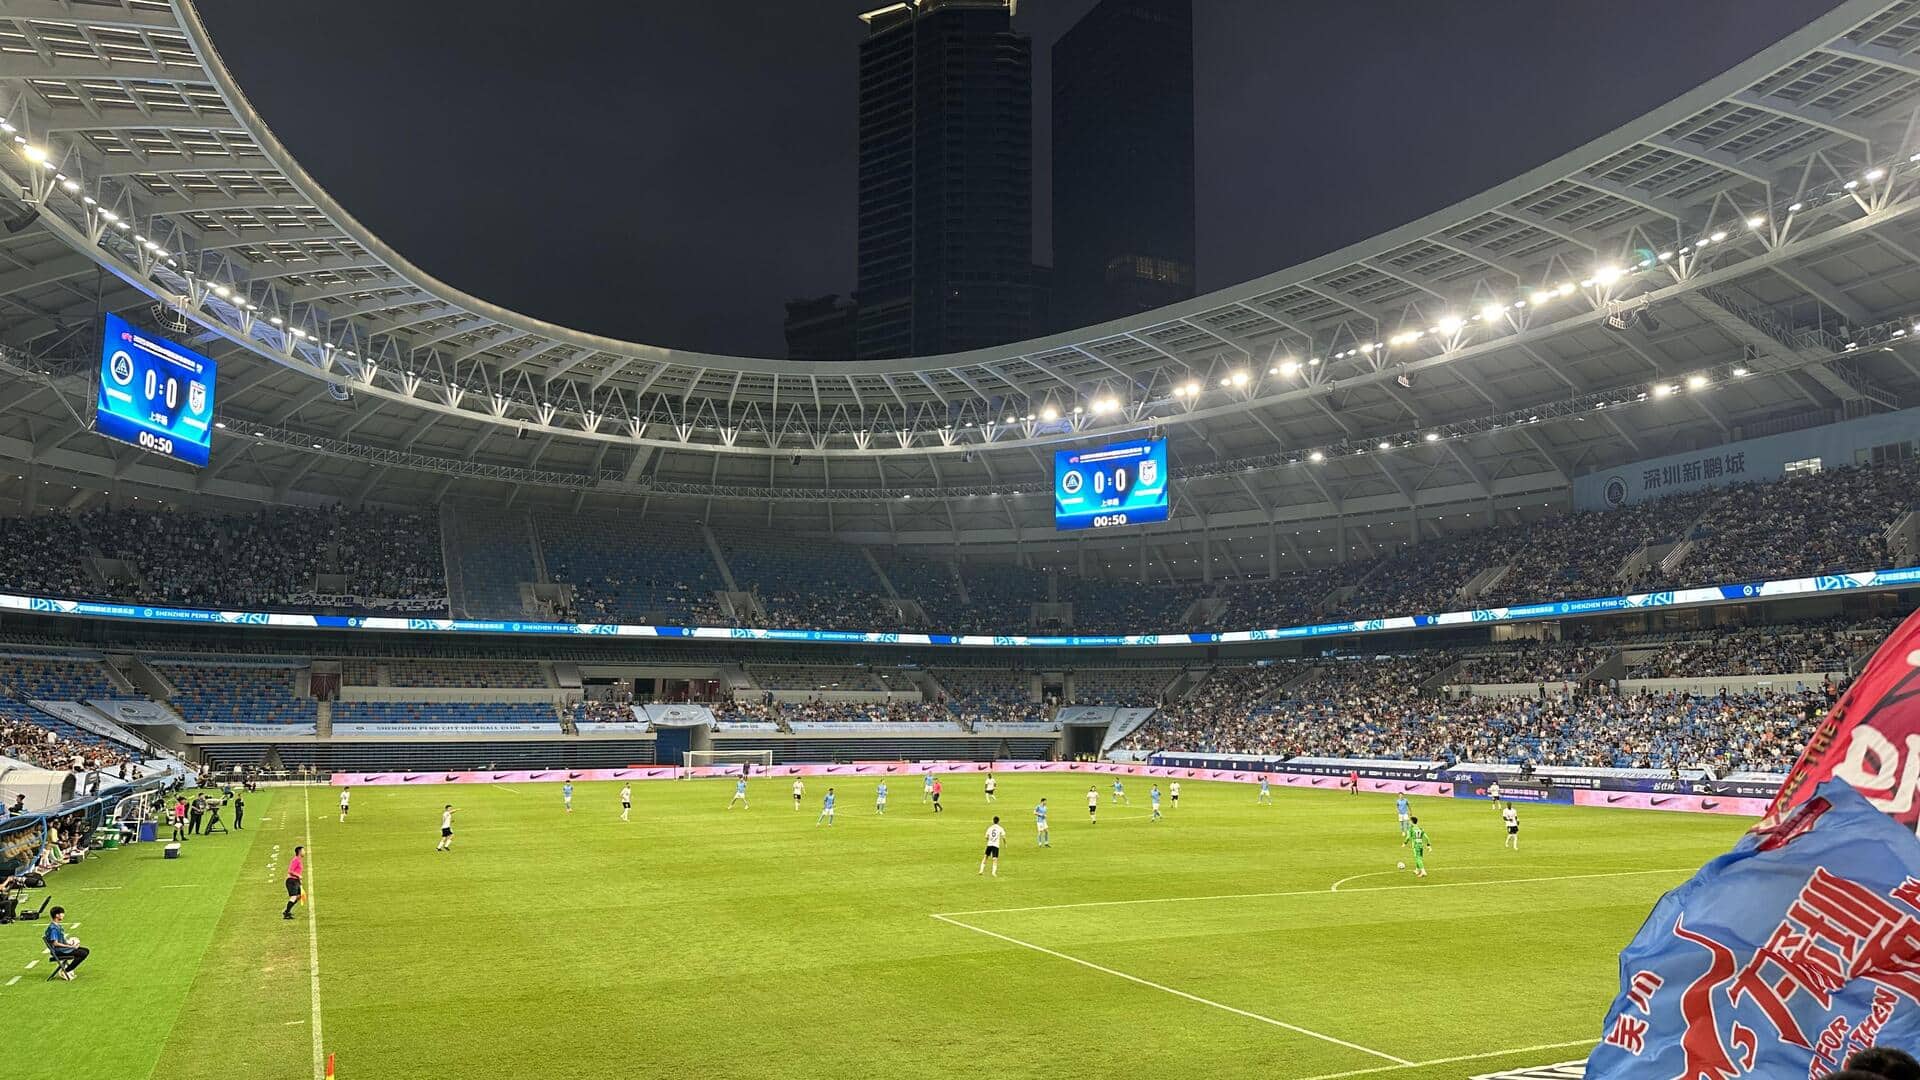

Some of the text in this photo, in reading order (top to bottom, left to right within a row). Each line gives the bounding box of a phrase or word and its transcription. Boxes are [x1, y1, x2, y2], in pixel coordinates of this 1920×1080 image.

[139, 431, 173, 453] 00:50
[1643, 452, 1745, 490] 深圳新鹏城
[1093, 514, 1127, 527] 00:50
[1804, 721, 1838, 766] THE
[1815, 1015, 1851, 1065] FOR
